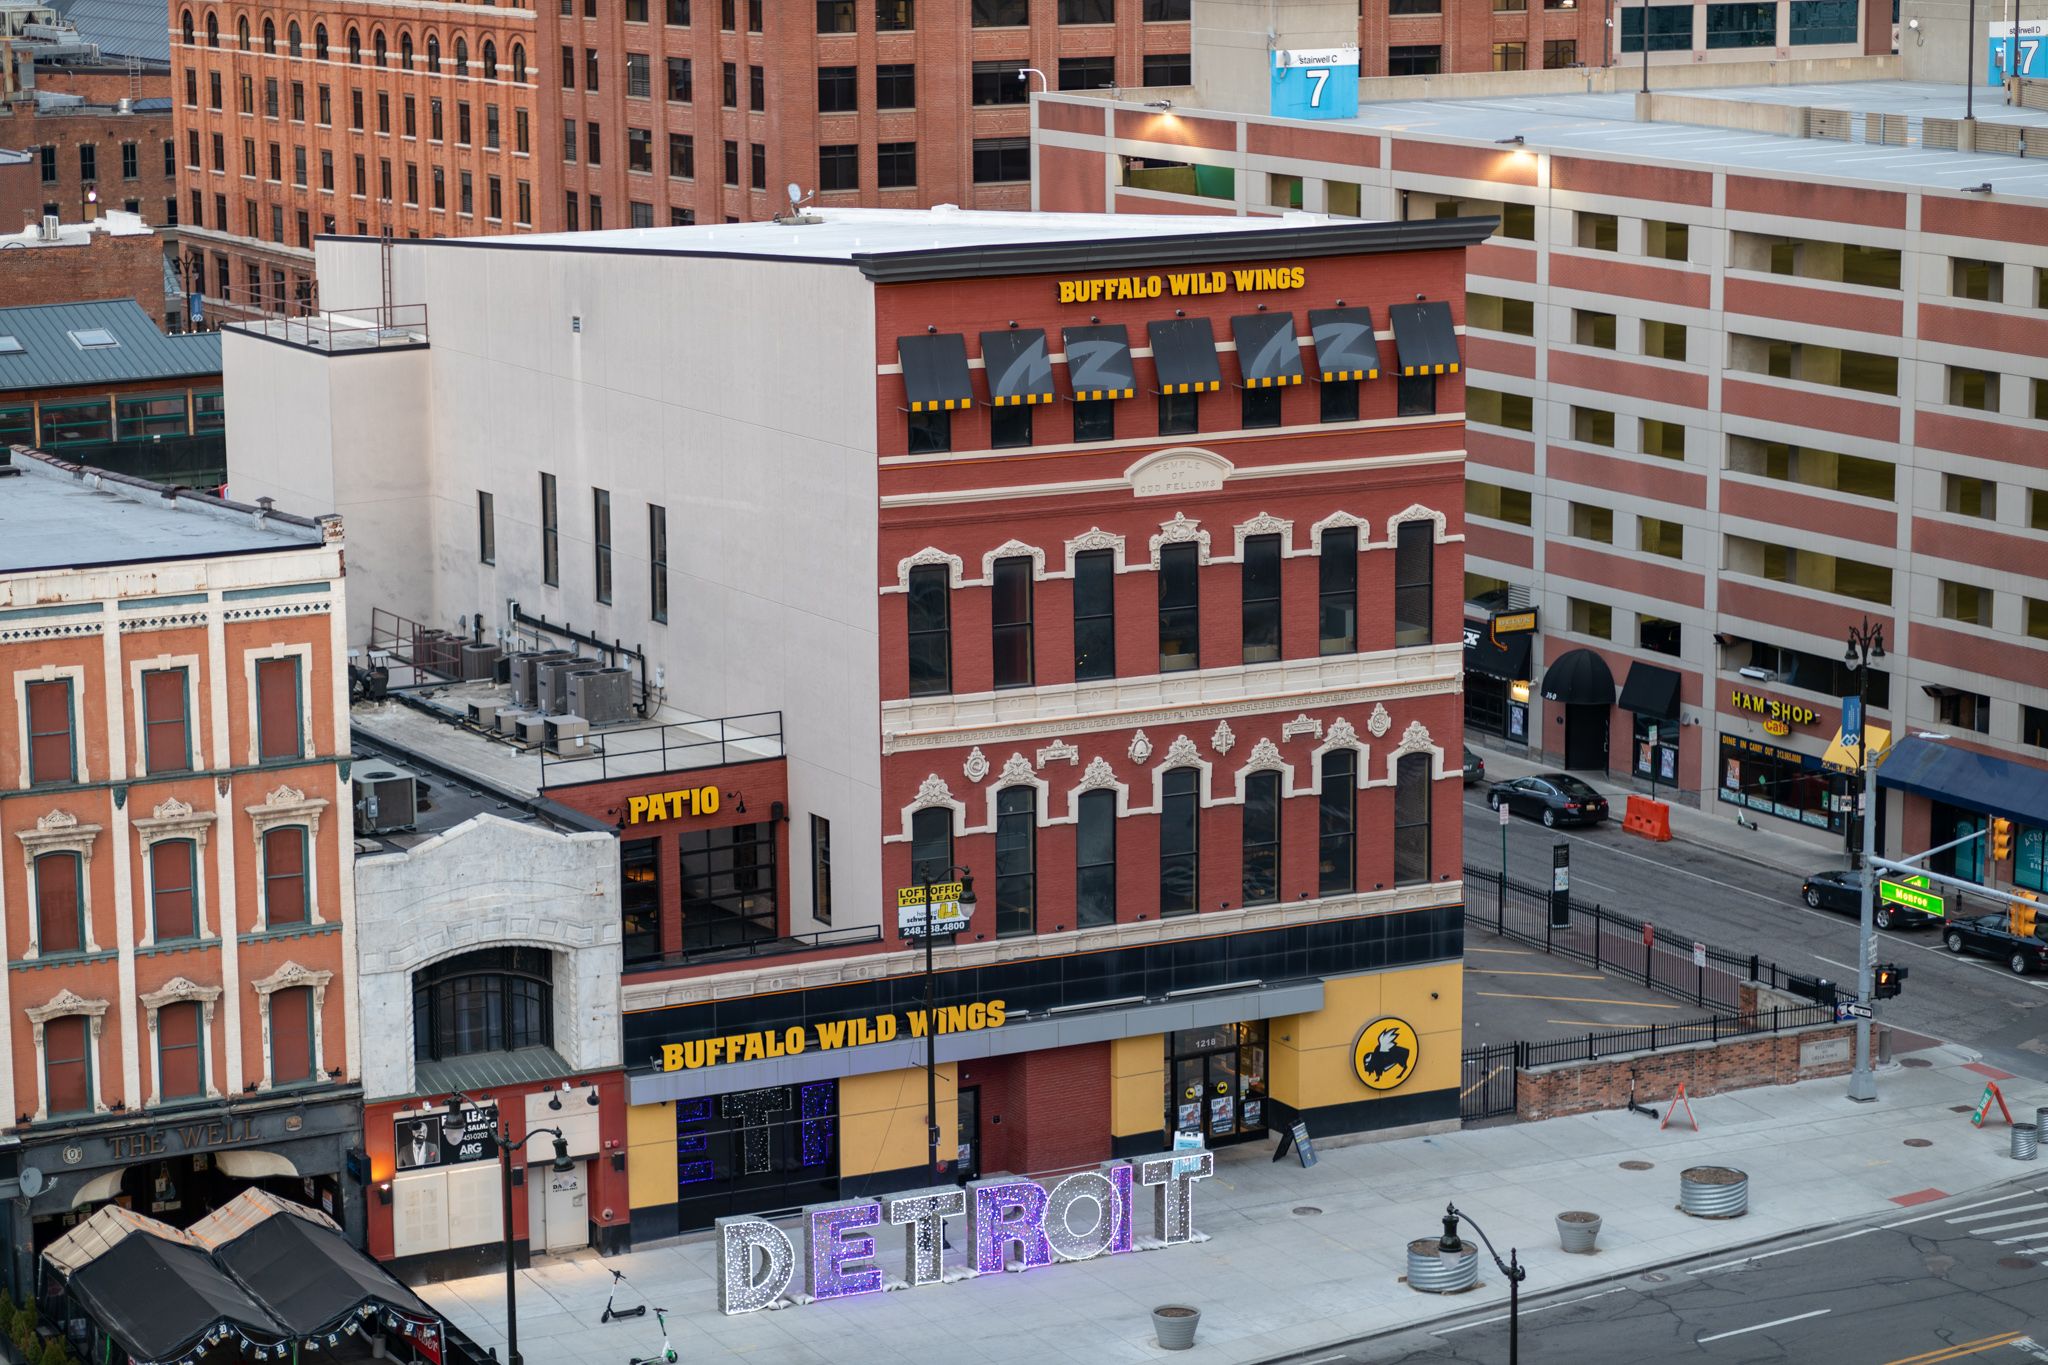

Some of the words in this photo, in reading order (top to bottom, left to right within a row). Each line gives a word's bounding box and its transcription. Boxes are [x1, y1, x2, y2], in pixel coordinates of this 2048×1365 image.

[2010, 26, 2035, 35] stirwell
[2036, 26, 2041, 34] D
[1299, 55, 1331, 65] stairwell
[1331, 54, 1338, 63] C
[2020, 39, 2039, 75] 7
[1306, 69, 1330, 108] 7
[1058, 275, 1162, 303] BUFFALO
[1167, 271, 1227, 296] WILD
[1232, 267, 1305, 292] WINGS
[1155, 460, 1201, 470] TEMPLE
[1171, 471, 1185, 479] OF
[1140, 484, 1161, 493] ODD
[1166, 480, 1216, 491] FELLOWS
[1732, 691, 1765, 713] HAM
[1771, 700, 1813, 725] SHOP
[1722, 735, 1737, 747] DINE
[1740, 739, 1747, 749] IN
[1749, 742, 1763, 753] CARRY
[1765, 746, 1774, 756] OUT
[628, 785, 720, 825] PATIO
[2024, 832, 2048, 848] ACRO
[900, 888, 927, 898] LOFT
[930, 884, 962, 895] OFFIC
[902, 897, 926, 905] FOR
[930, 893, 959, 902] LEAS
[1895, 888, 1928, 907] Monroe
[661, 1026, 805, 1072] BUFFALO
[815, 1014, 897, 1051] WILD
[906, 1000, 1006, 1038] WINGS
[1195, 1038, 1216, 1048] 1218
[107, 1132, 167, 1160] THE
[178, 1118, 262, 1150] WELL
[459, 1142, 482, 1155] ARG
[716, 1150, 1214, 1316] DETROIT
